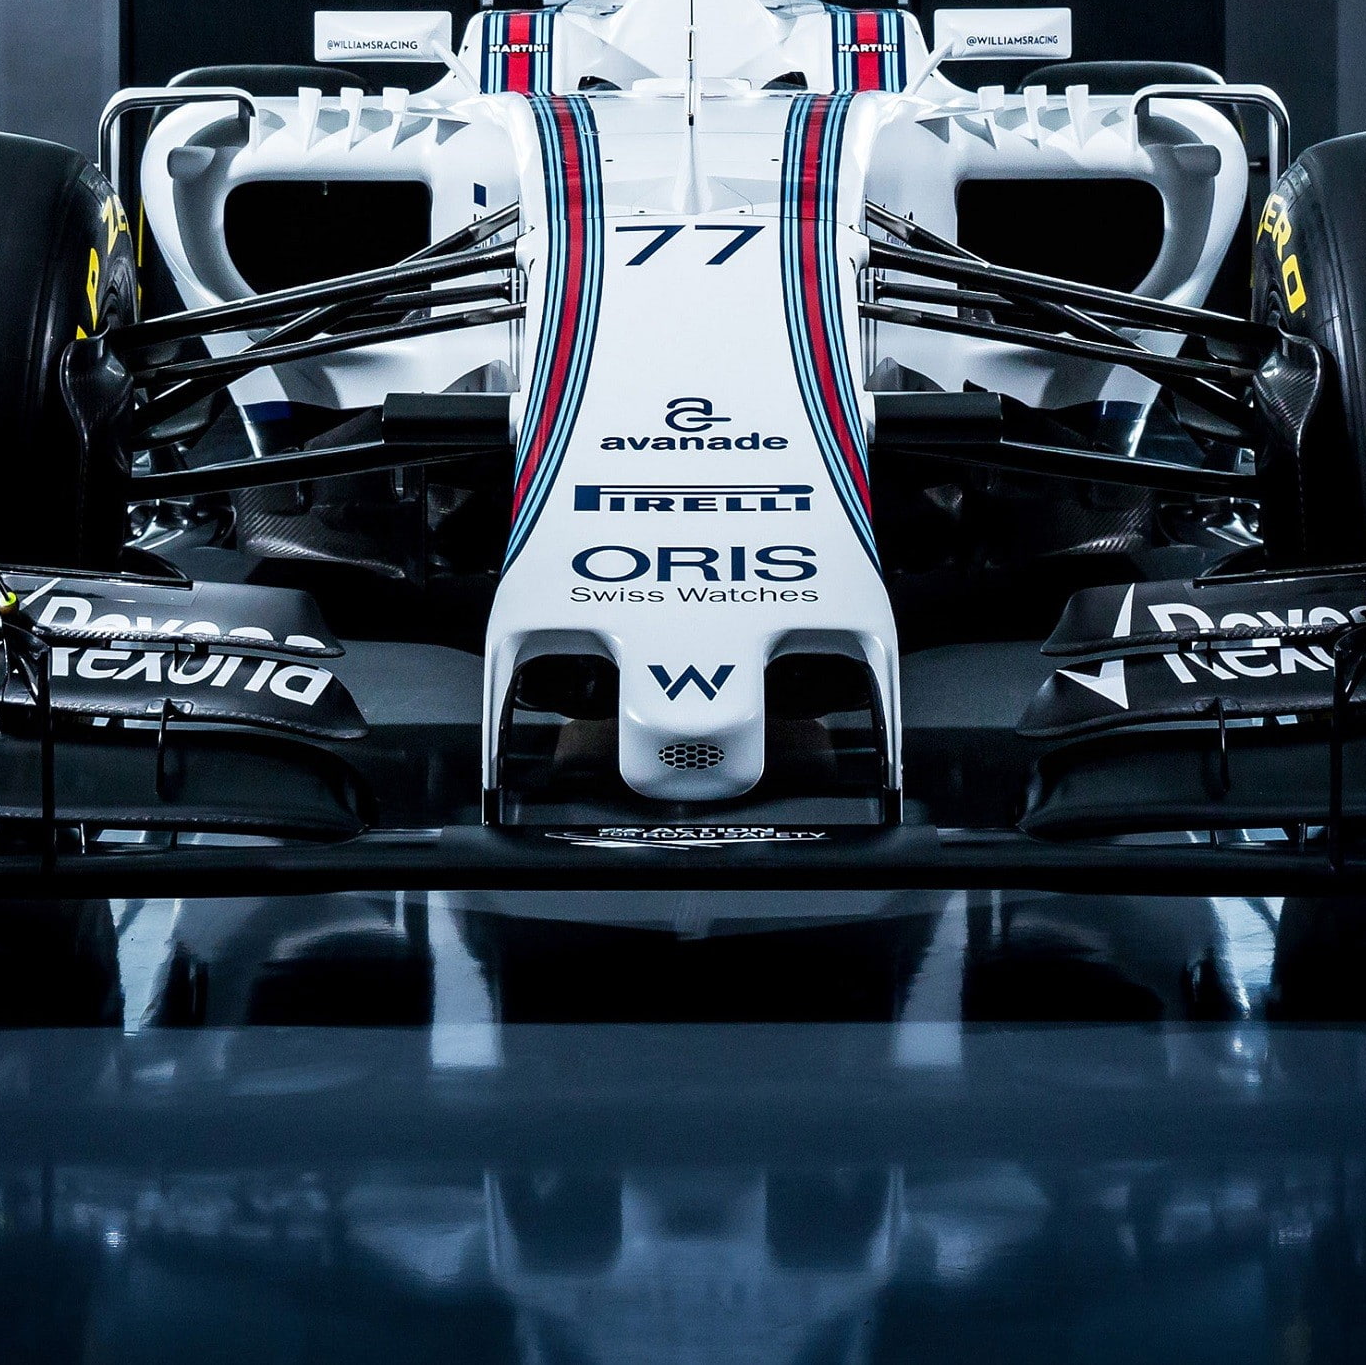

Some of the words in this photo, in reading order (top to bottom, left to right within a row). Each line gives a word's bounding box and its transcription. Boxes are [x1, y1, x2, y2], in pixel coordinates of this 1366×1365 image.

[326, 40, 418, 50] @WILLIAMSRACING
[489, 44, 549, 53] MARTINI
[838, 43, 898, 53] MARTINI
[966, 35, 1058, 46] @WILLIAMSRACING
[615, 224, 767, 267] 77
[600, 432, 789, 451] avanade
[573, 484, 815, 512] PIRELLI
[571, 545, 818, 582] ORIS
[570, 587, 665, 603] Swiss
[677, 587, 820, 604] Watches
